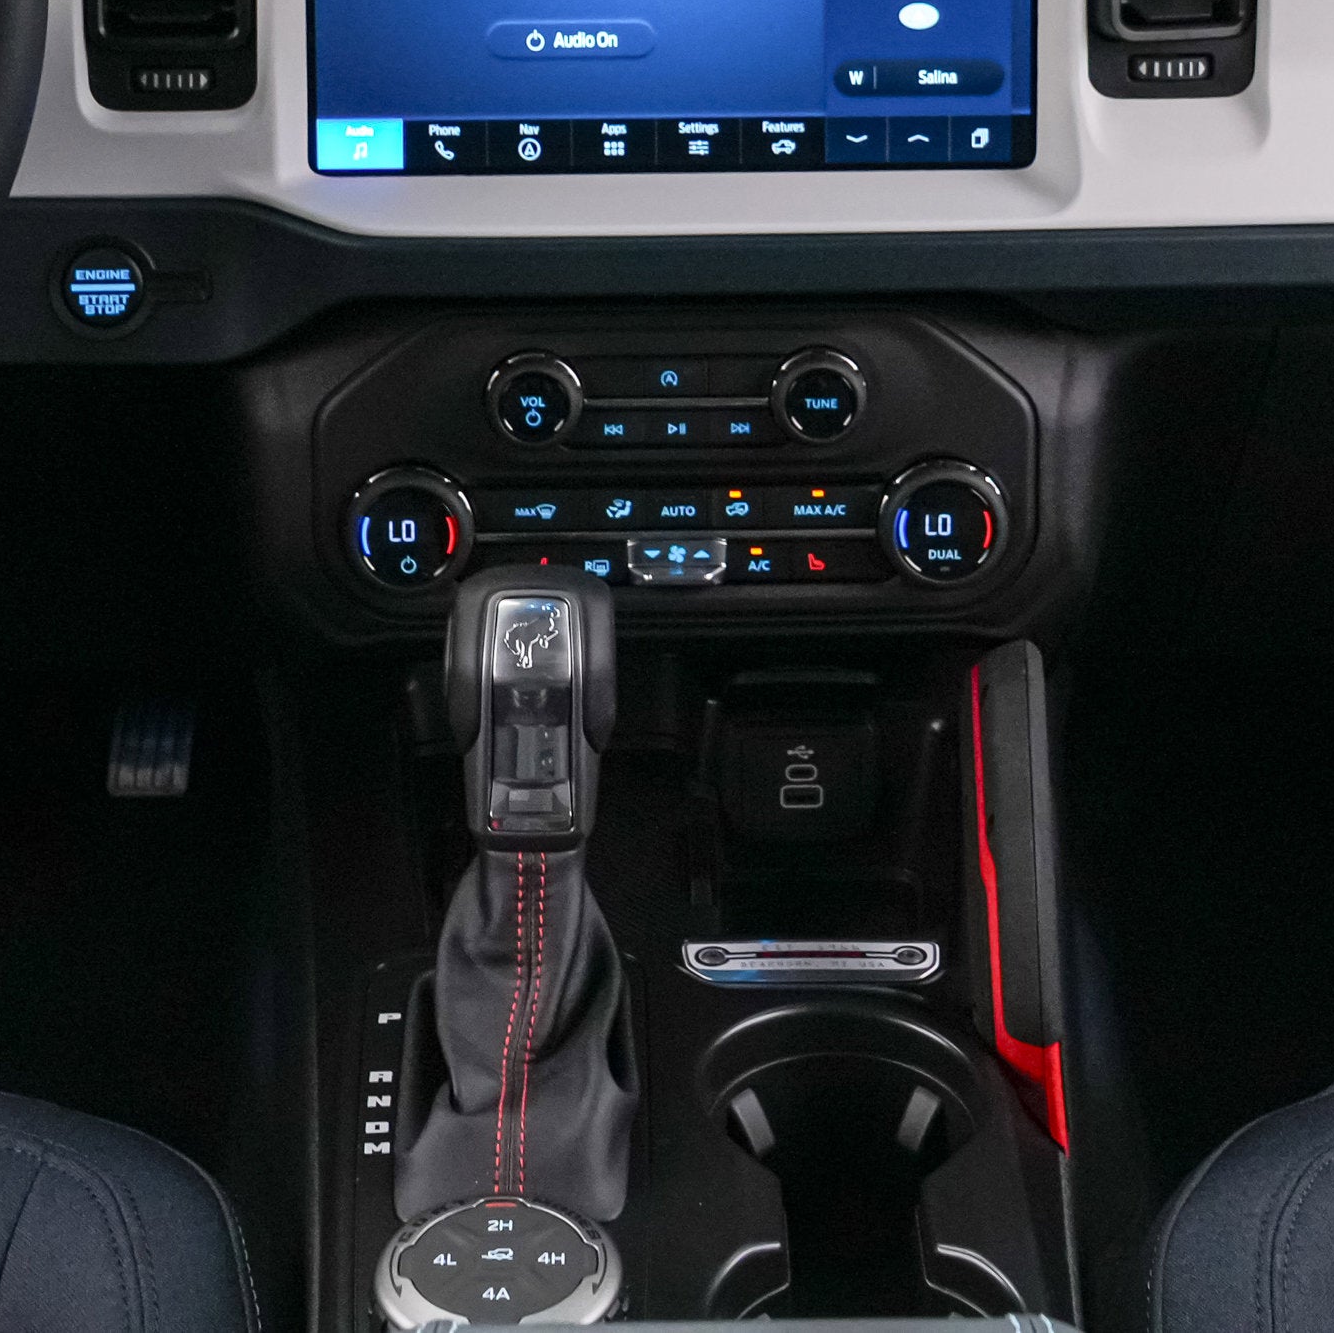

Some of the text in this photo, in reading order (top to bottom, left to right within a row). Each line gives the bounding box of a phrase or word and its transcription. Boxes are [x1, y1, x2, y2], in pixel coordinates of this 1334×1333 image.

[553, 32, 618, 48] Audio On
[848, 70, 864, 86] W
[918, 69, 958, 86] Salina
[345, 125, 374, 137] Audio
[428, 124, 461, 137] Phone
[519, 124, 539, 136] Nav
[601, 123, 627, 137] Apps
[678, 122, 719, 137] Settings
[762, 121, 805, 134] Features
[75, 269, 130, 280] ENGINE
[78, 294, 130, 305] START
[85, 304, 126, 315] STOP
[520, 396, 545, 408] VOL
[804, 397, 838, 410] TUNE
[514, 506, 537, 517] MAX
[661, 505, 696, 518] AUTO
[793, 503, 847, 517] MAX A/C
[388, 520, 416, 543] LO
[924, 513, 952, 537] LO
[928, 548, 962, 561] DUAL
[747, 559, 771, 573] A/C
[378, 1012, 402, 1024] P
[367, 1095, 391, 1108] N
[365, 1121, 390, 1134] D
[364, 1141, 391, 1154] M
[487, 1219, 513, 1232] 2H
[433, 1253, 457, 1266] 4L
[537, 1252, 566, 1266] 4H
[482, 1287, 511, 1301] 4A
